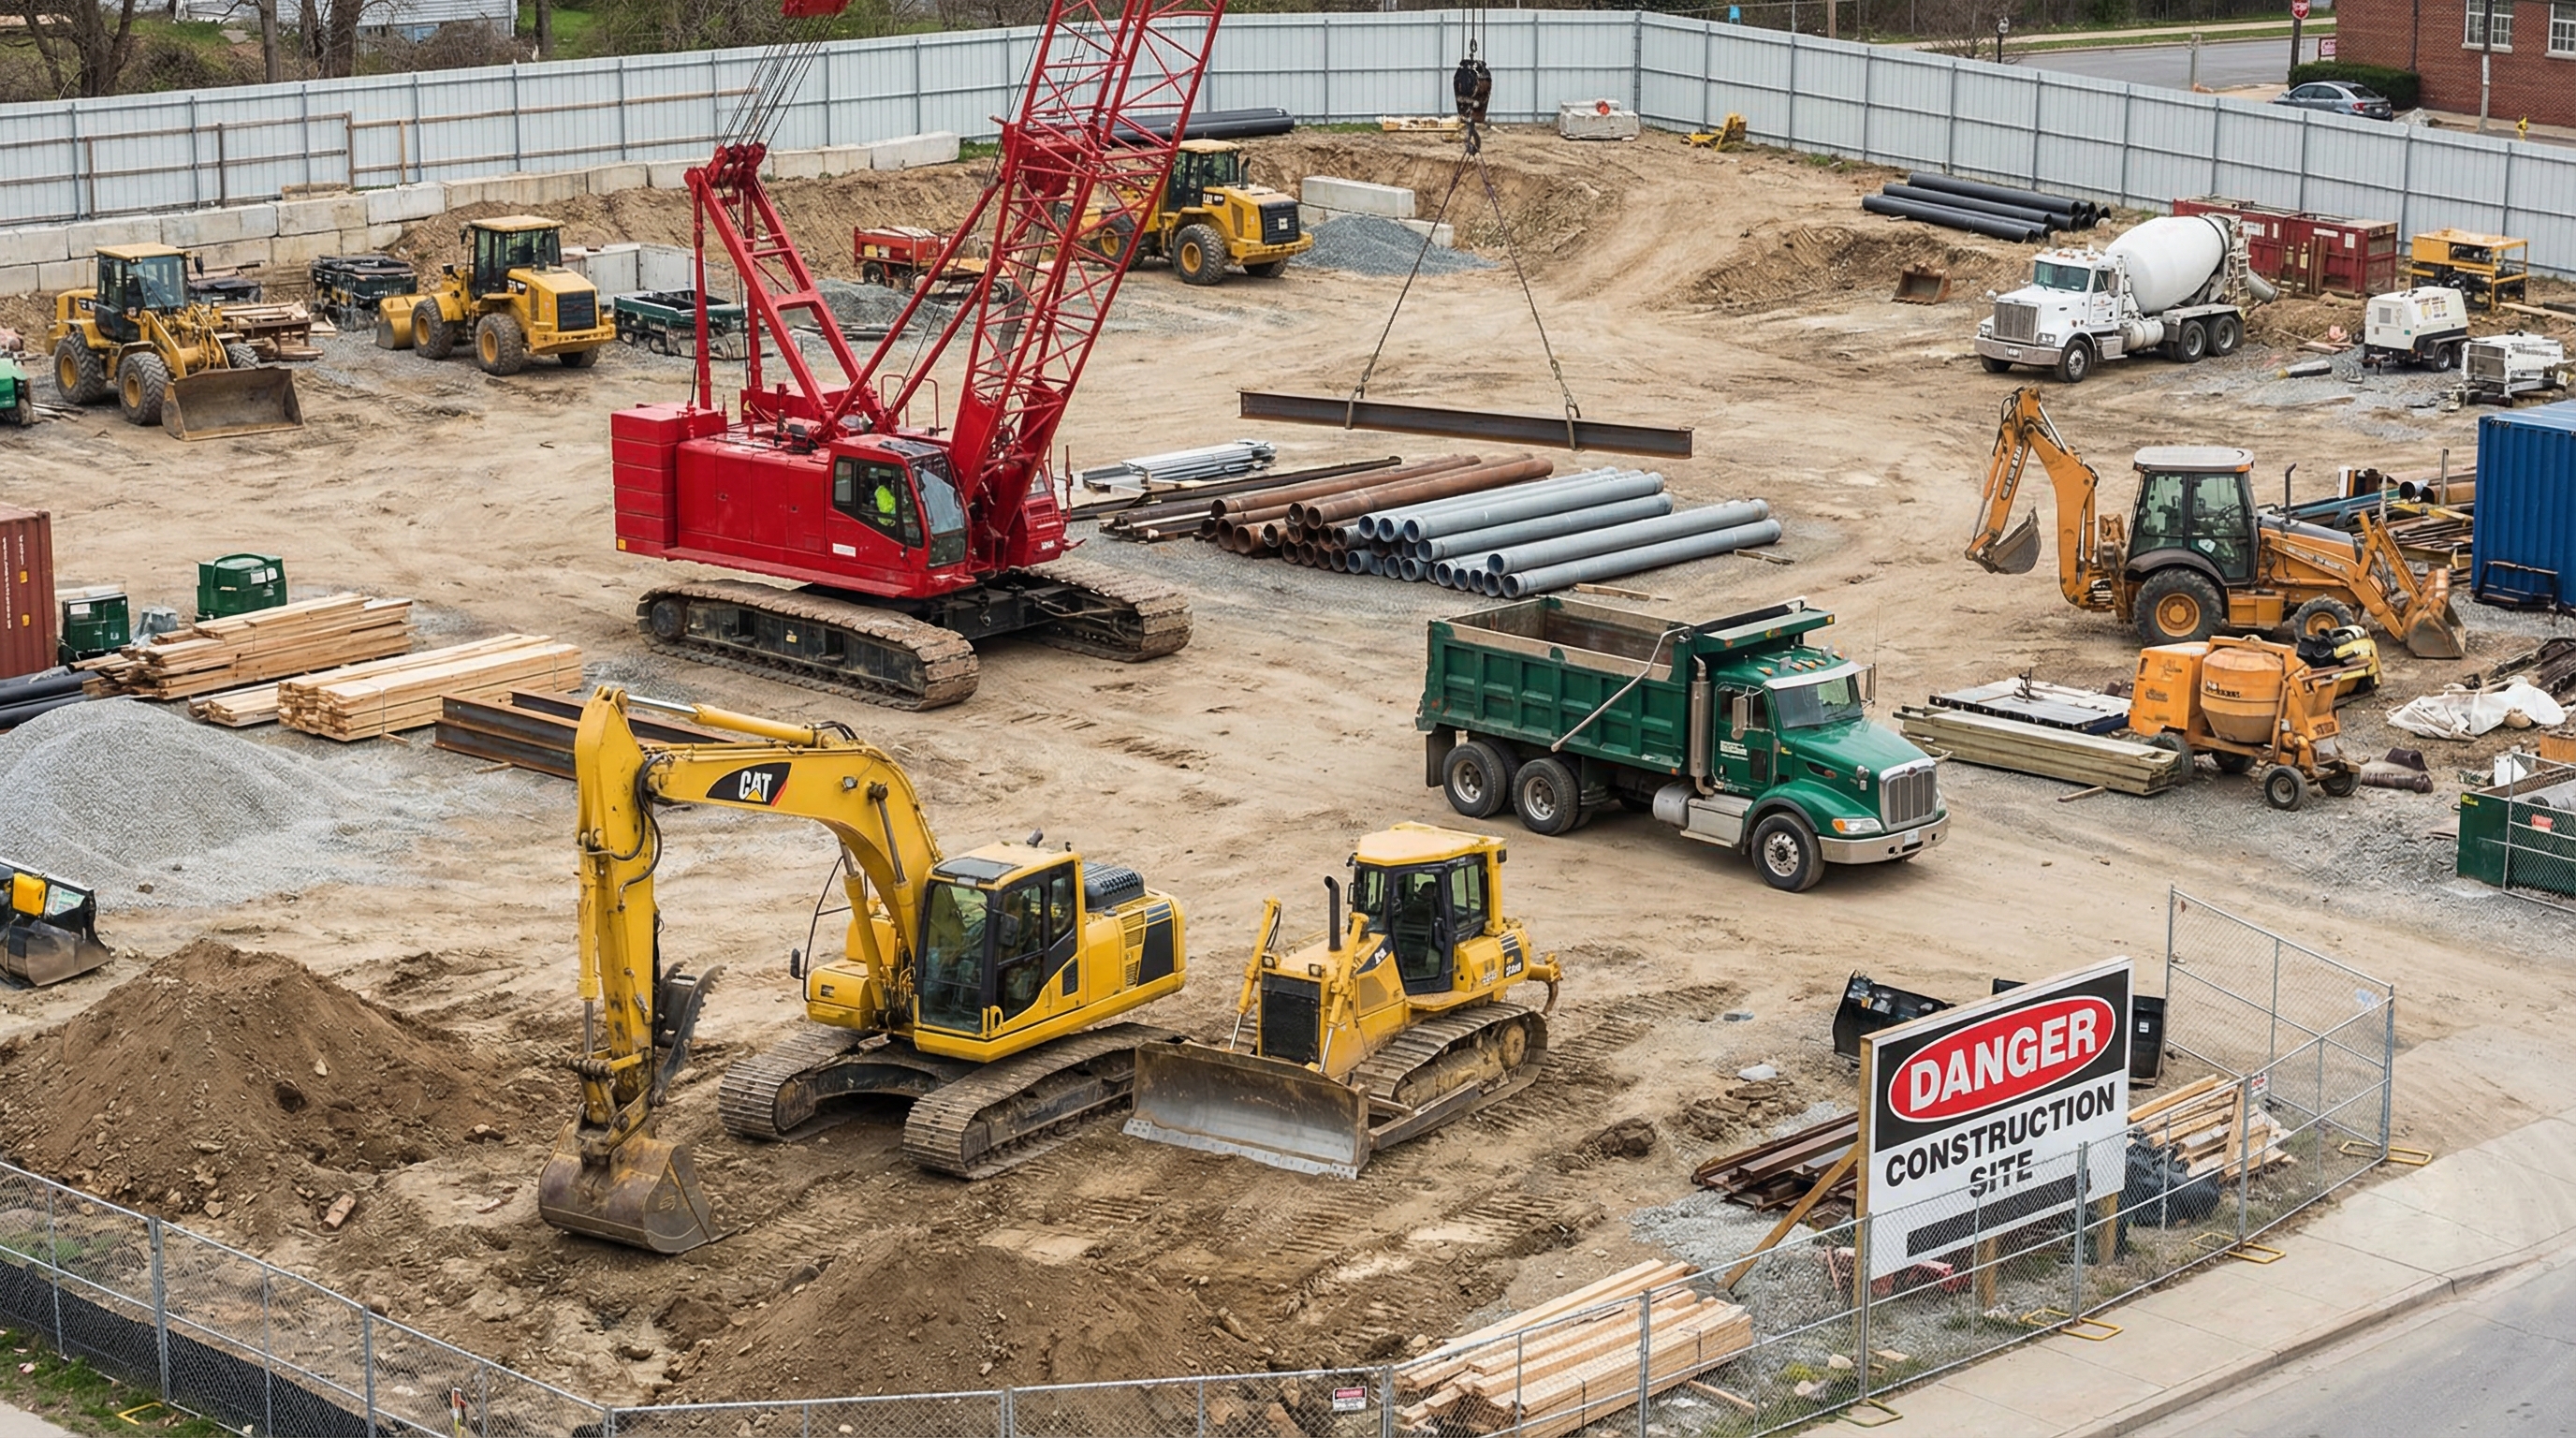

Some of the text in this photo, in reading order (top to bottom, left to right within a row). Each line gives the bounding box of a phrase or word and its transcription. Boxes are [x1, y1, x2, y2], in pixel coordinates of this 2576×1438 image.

[739, 770, 772, 802] CAT
[1910, 1007, 2097, 1112] DANGER
[1885, 1080, 2115, 1187] CONSTRUCTION
[1969, 1149, 2033, 1198] SITE
